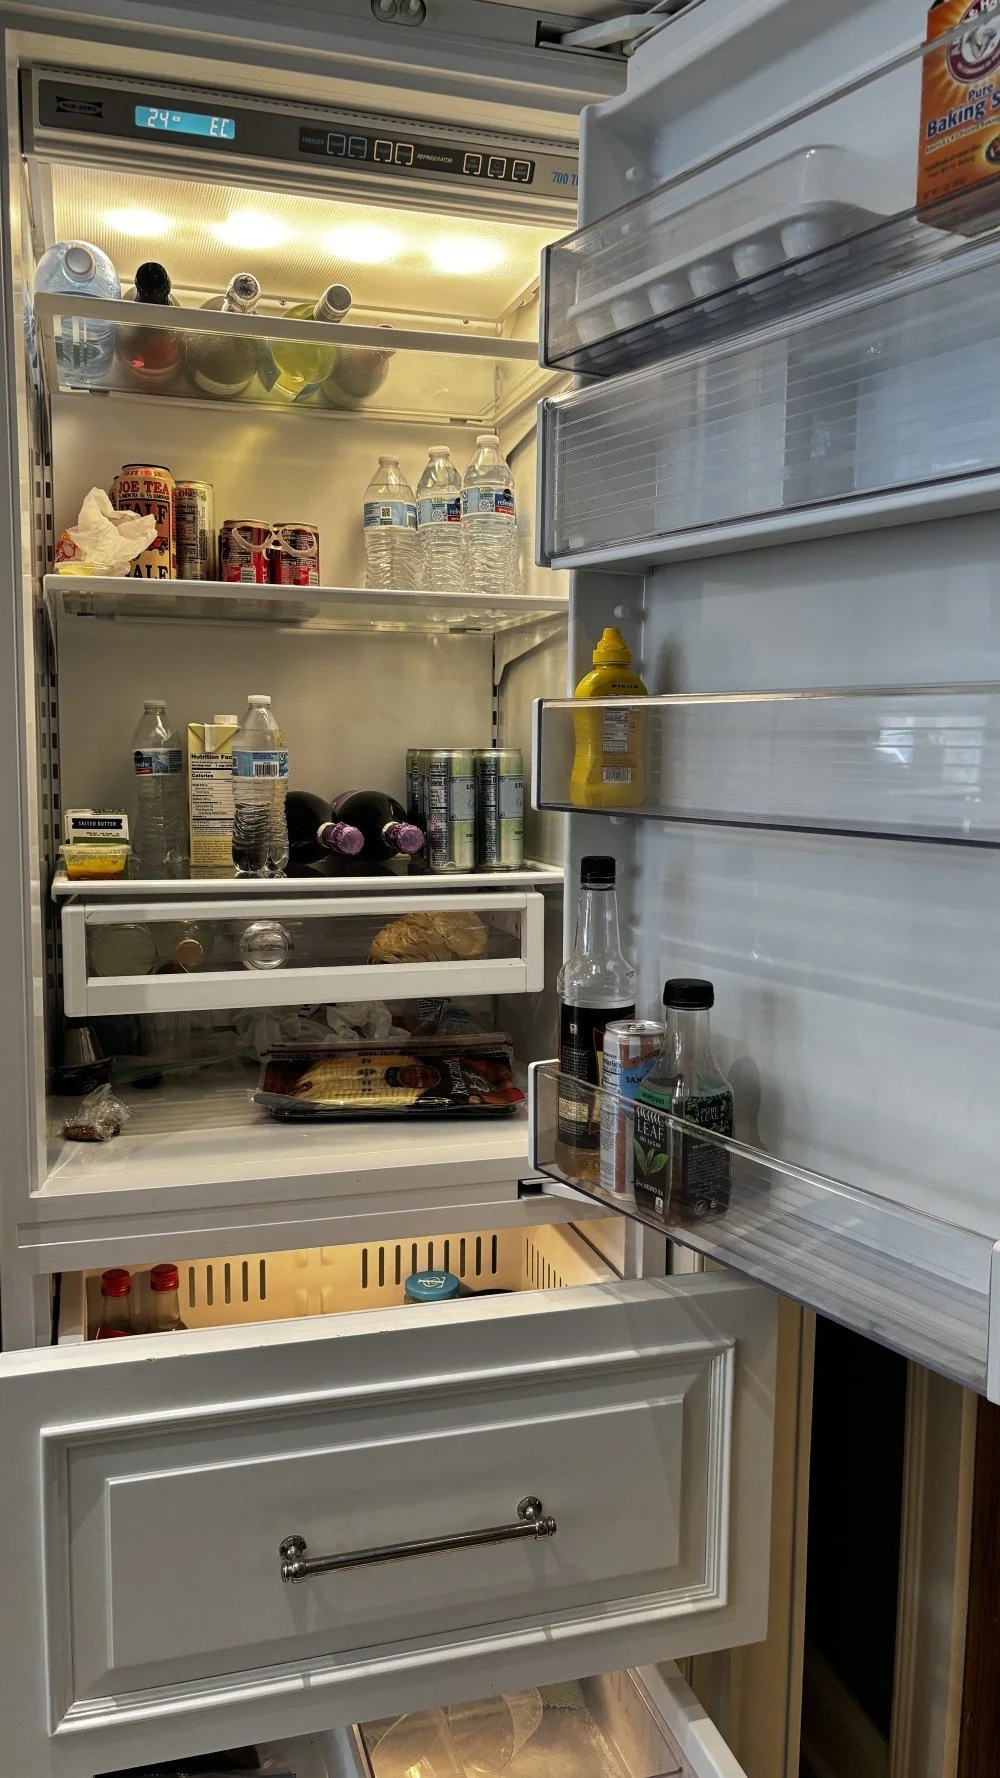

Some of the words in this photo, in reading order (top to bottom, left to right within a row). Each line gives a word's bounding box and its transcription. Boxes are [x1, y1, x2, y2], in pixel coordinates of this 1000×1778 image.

[968, 84, 993, 103] Pure
[147, 108, 169, 128] 24
[209, 116, 230, 138] EC
[926, 100, 986, 139] Baking
[302, 136, 325, 145] FREEZER
[416, 153, 454, 163] REFRIGERATOR
[552, 171, 569, 185] 700
[118, 480, 140, 493] JOE
[144, 480, 170, 495] TEA
[625, 1076, 643, 1084] SAN
[700, 1106, 719, 1115] PURE
[700, 1114, 720, 1122] LEAF
[637, 1118, 665, 1141] LEAF
